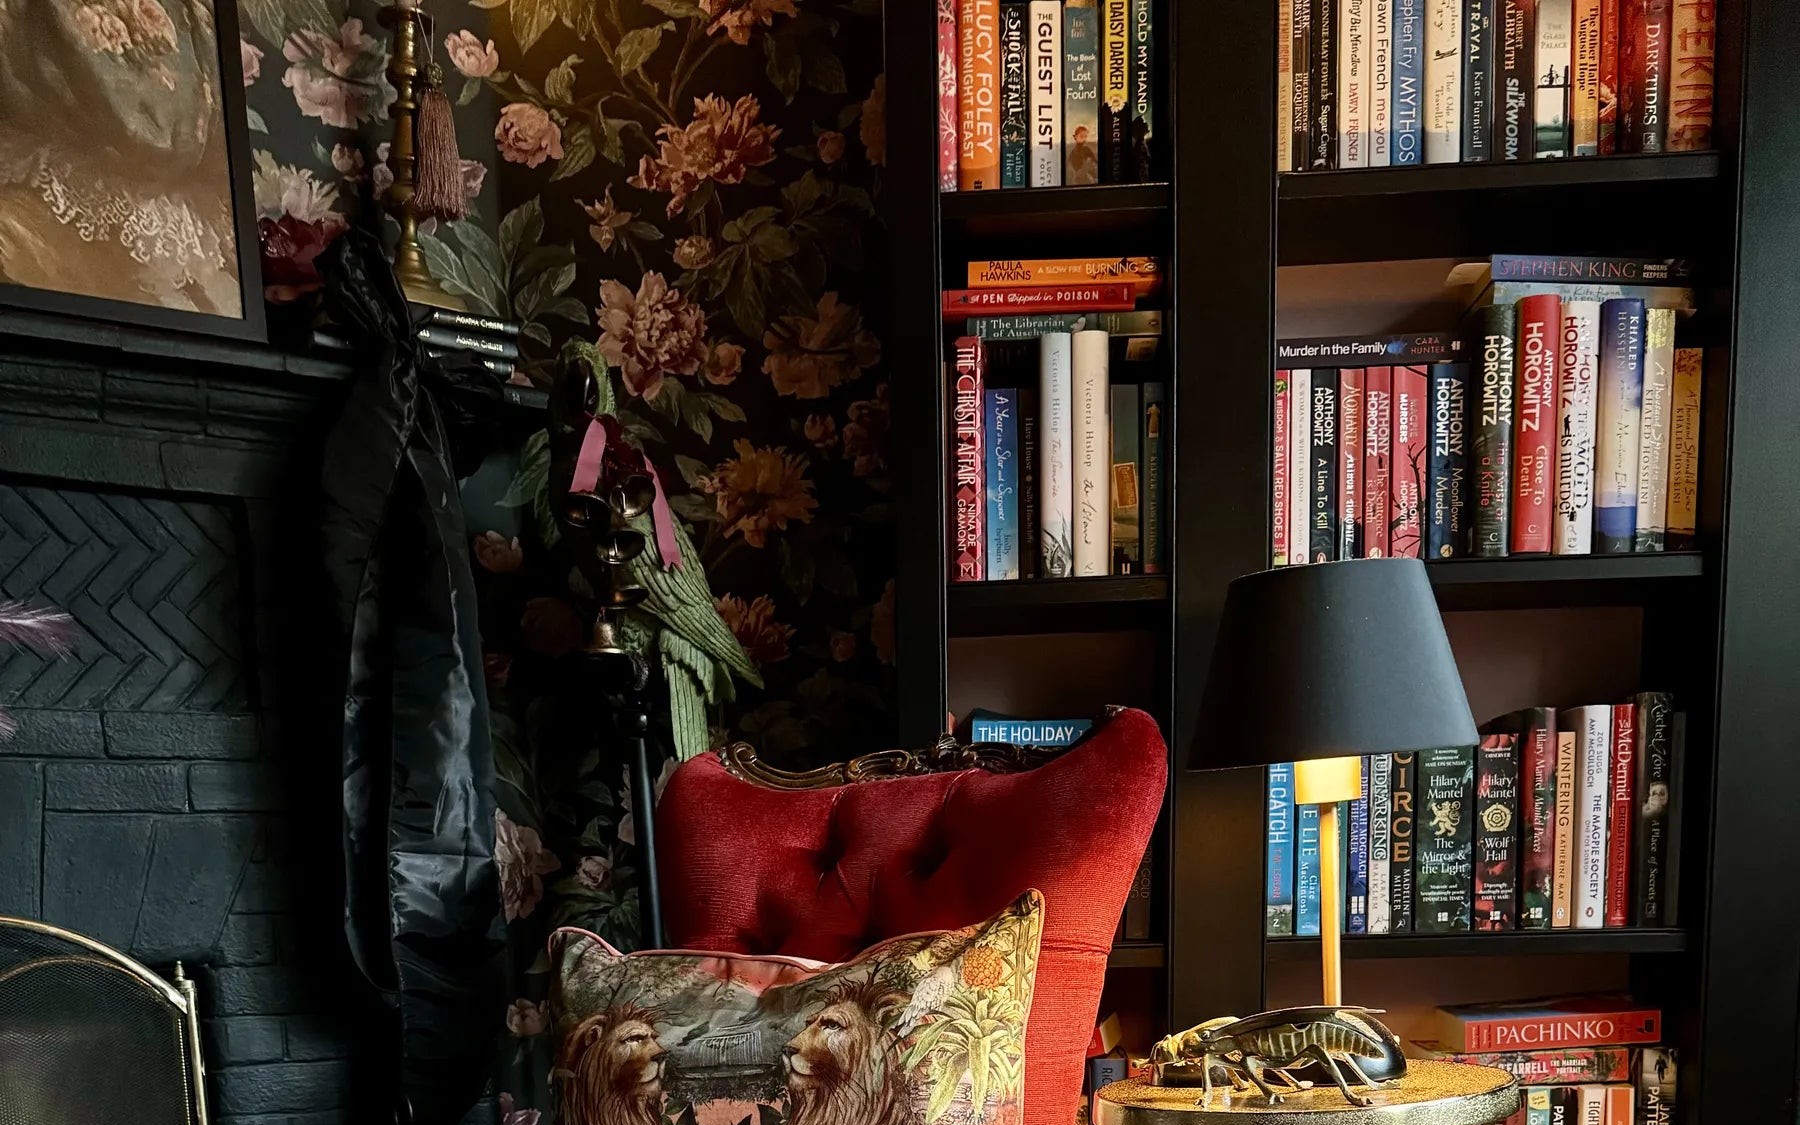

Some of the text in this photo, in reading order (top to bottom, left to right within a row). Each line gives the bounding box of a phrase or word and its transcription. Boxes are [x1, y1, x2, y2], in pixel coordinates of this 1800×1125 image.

[1110, 2, 1124, 90] DAISY DARKER
[1138, 1, 1147, 113] HOLD MY HAND
[1321, 0, 1330, 101] CONNIE MAY FOWLER
[1516, 10, 1524, 49] ROBERT
[1577, 17, 1589, 91] Augusta Hope
[976, 1, 993, 153] LUCY FOLEY
[1038, 22, 1053, 150] GUEST LIST
[1067, 89, 1096, 100] Found
[1294, 73, 1302, 132] ELOQUENCE
[1643, 23, 1660, 125] DARK TIDES
[1317, 105, 1330, 158] Sugar Cage
[1347, 83, 1358, 162] DAWN FRENCH
[1398, 77, 1416, 162] MYTHOS
[1505, 78, 1519, 160] SILKWORM
[980, 271, 1032, 281] HAWKINS
[989, 261, 1023, 271] PAULA
[1500, 260, 1637, 278] STEPHEN KING
[991, 318, 1065, 330] The Librarian
[1279, 342, 1387, 358] Murder in the Family
[1628, 315, 1639, 370] KHALED
[1482, 335, 1499, 426] HOROWITZ
[1498, 335, 1512, 425] ANTHONY
[1522, 322, 1543, 432] HOROWITZ
[1543, 349, 1553, 407] ANTHONY
[1562, 316, 1578, 409] HOROWITZ
[954, 346, 976, 487] THE CHRISTIE AFFAIR
[1050, 350, 1060, 434] Victoria Hislop
[1314, 387, 1324, 446] HOROWITZ
[1324, 387, 1334, 445] ANTHONY
[1399, 393, 1408, 443] MURDERS
[1436, 378, 1449, 457] HOROWITZ
[1450, 378, 1463, 455] ANTHONY
[1025, 417, 1034, 470] Hare House
[1083, 379, 1094, 467] Victoria Hislop
[1366, 391, 1377, 456] HOROWITZ
[1378, 391, 1388, 456] ANTHONY
[1640, 389, 1653, 505] KHALED HOSSEINI
[1520, 455, 1532, 497] Death
[1534, 445, 1547, 505] Close To
[1673, 407, 1683, 504] KHALED HOSSEINI
[1317, 458, 1328, 529] A Line To Kill
[1435, 476, 1448, 525] Murders
[957, 499, 966, 552] GRAMONT
[967, 503, 976, 547] NINA DE
[978, 726, 1074, 743] THE HOLIDAY
[1534, 728, 1547, 791] Hilary Mantel
[1427, 787, 1463, 799] Mantel
[1430, 775, 1461, 788] Hilary
[1479, 787, 1516, 799] Mantel
[1483, 775, 1513, 787] Hilary
[1559, 742, 1572, 827] WINTERING
[1422, 851, 1465, 862] Mirror &
[1422, 862, 1465, 874] the Light
[1434, 838, 1454, 849] The
[1485, 837, 1510, 849] Wolf
[1485, 851, 1506, 862] Hall
[1558, 833, 1566, 878] KATHERINE
[1590, 794, 1602, 900] THE MAGPIE SOCIETY
[1300, 861, 1309, 914] Mackintosh
[1309, 875, 1317, 899] Clare
[1393, 875, 1401, 911] MILLER
[1496, 1020, 1615, 1045] PACHINKO
